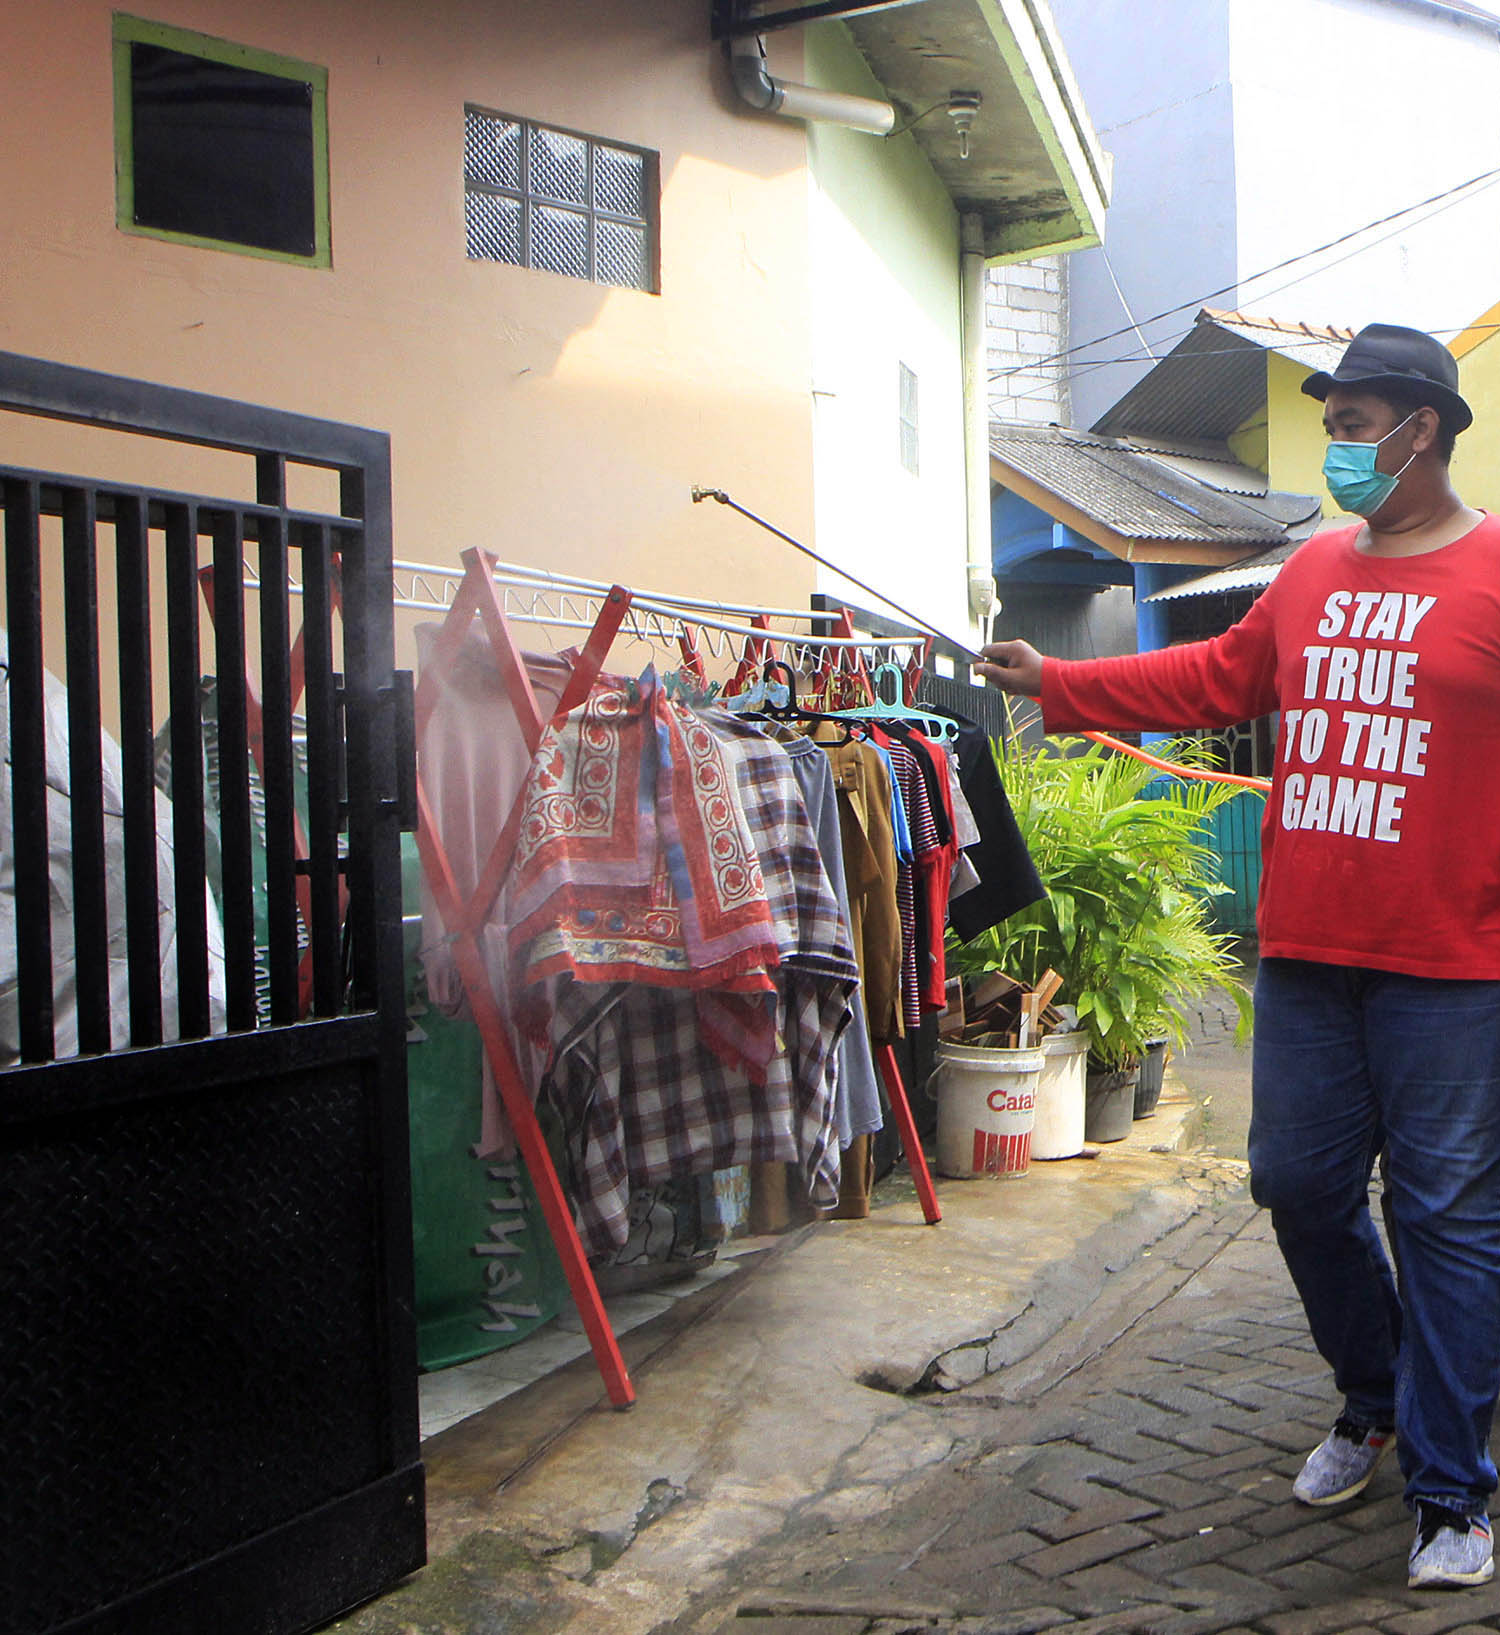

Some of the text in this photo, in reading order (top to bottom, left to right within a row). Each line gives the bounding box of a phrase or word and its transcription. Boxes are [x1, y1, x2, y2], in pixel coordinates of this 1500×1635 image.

[1317, 590, 1438, 643] STAY
[1302, 646, 1419, 709] TRUE
[1284, 708, 1432, 777] TO THE
[1281, 773, 1407, 843] GAME
